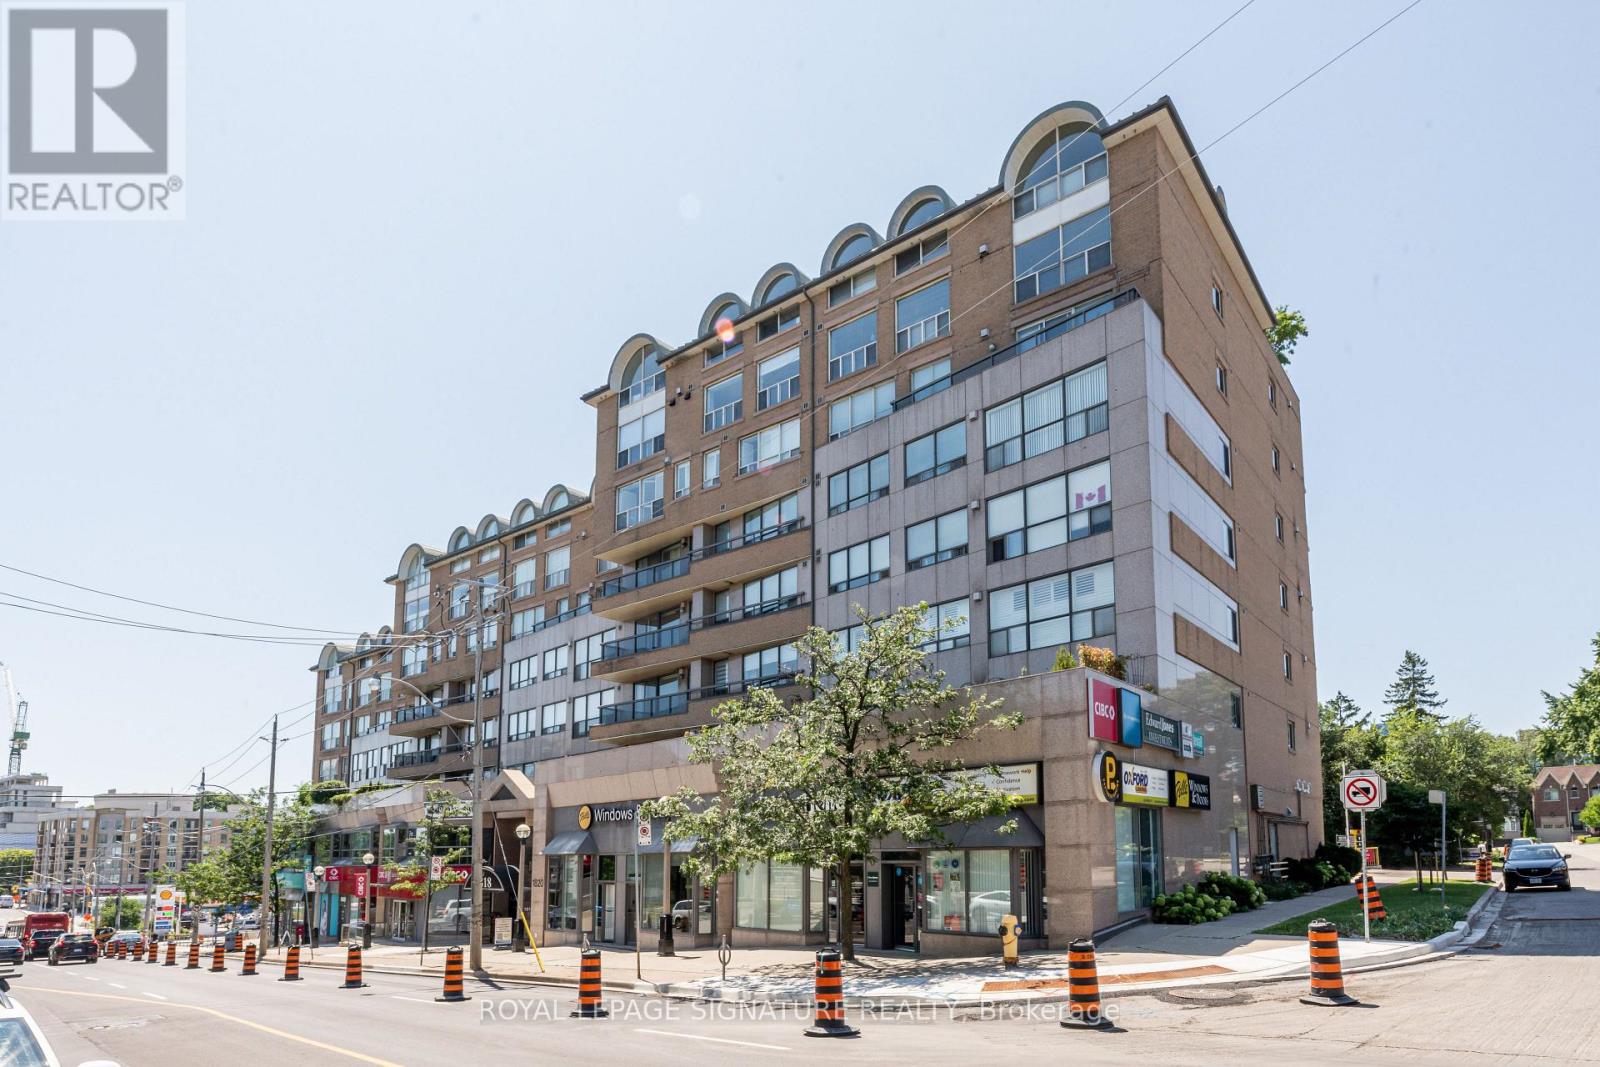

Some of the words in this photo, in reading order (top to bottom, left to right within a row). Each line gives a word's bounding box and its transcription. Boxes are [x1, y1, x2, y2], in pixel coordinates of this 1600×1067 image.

[1094, 702, 1110, 719] CIBC
[1124, 767, 1149, 787] OXFORD
[594, 808, 633, 822] Windows
